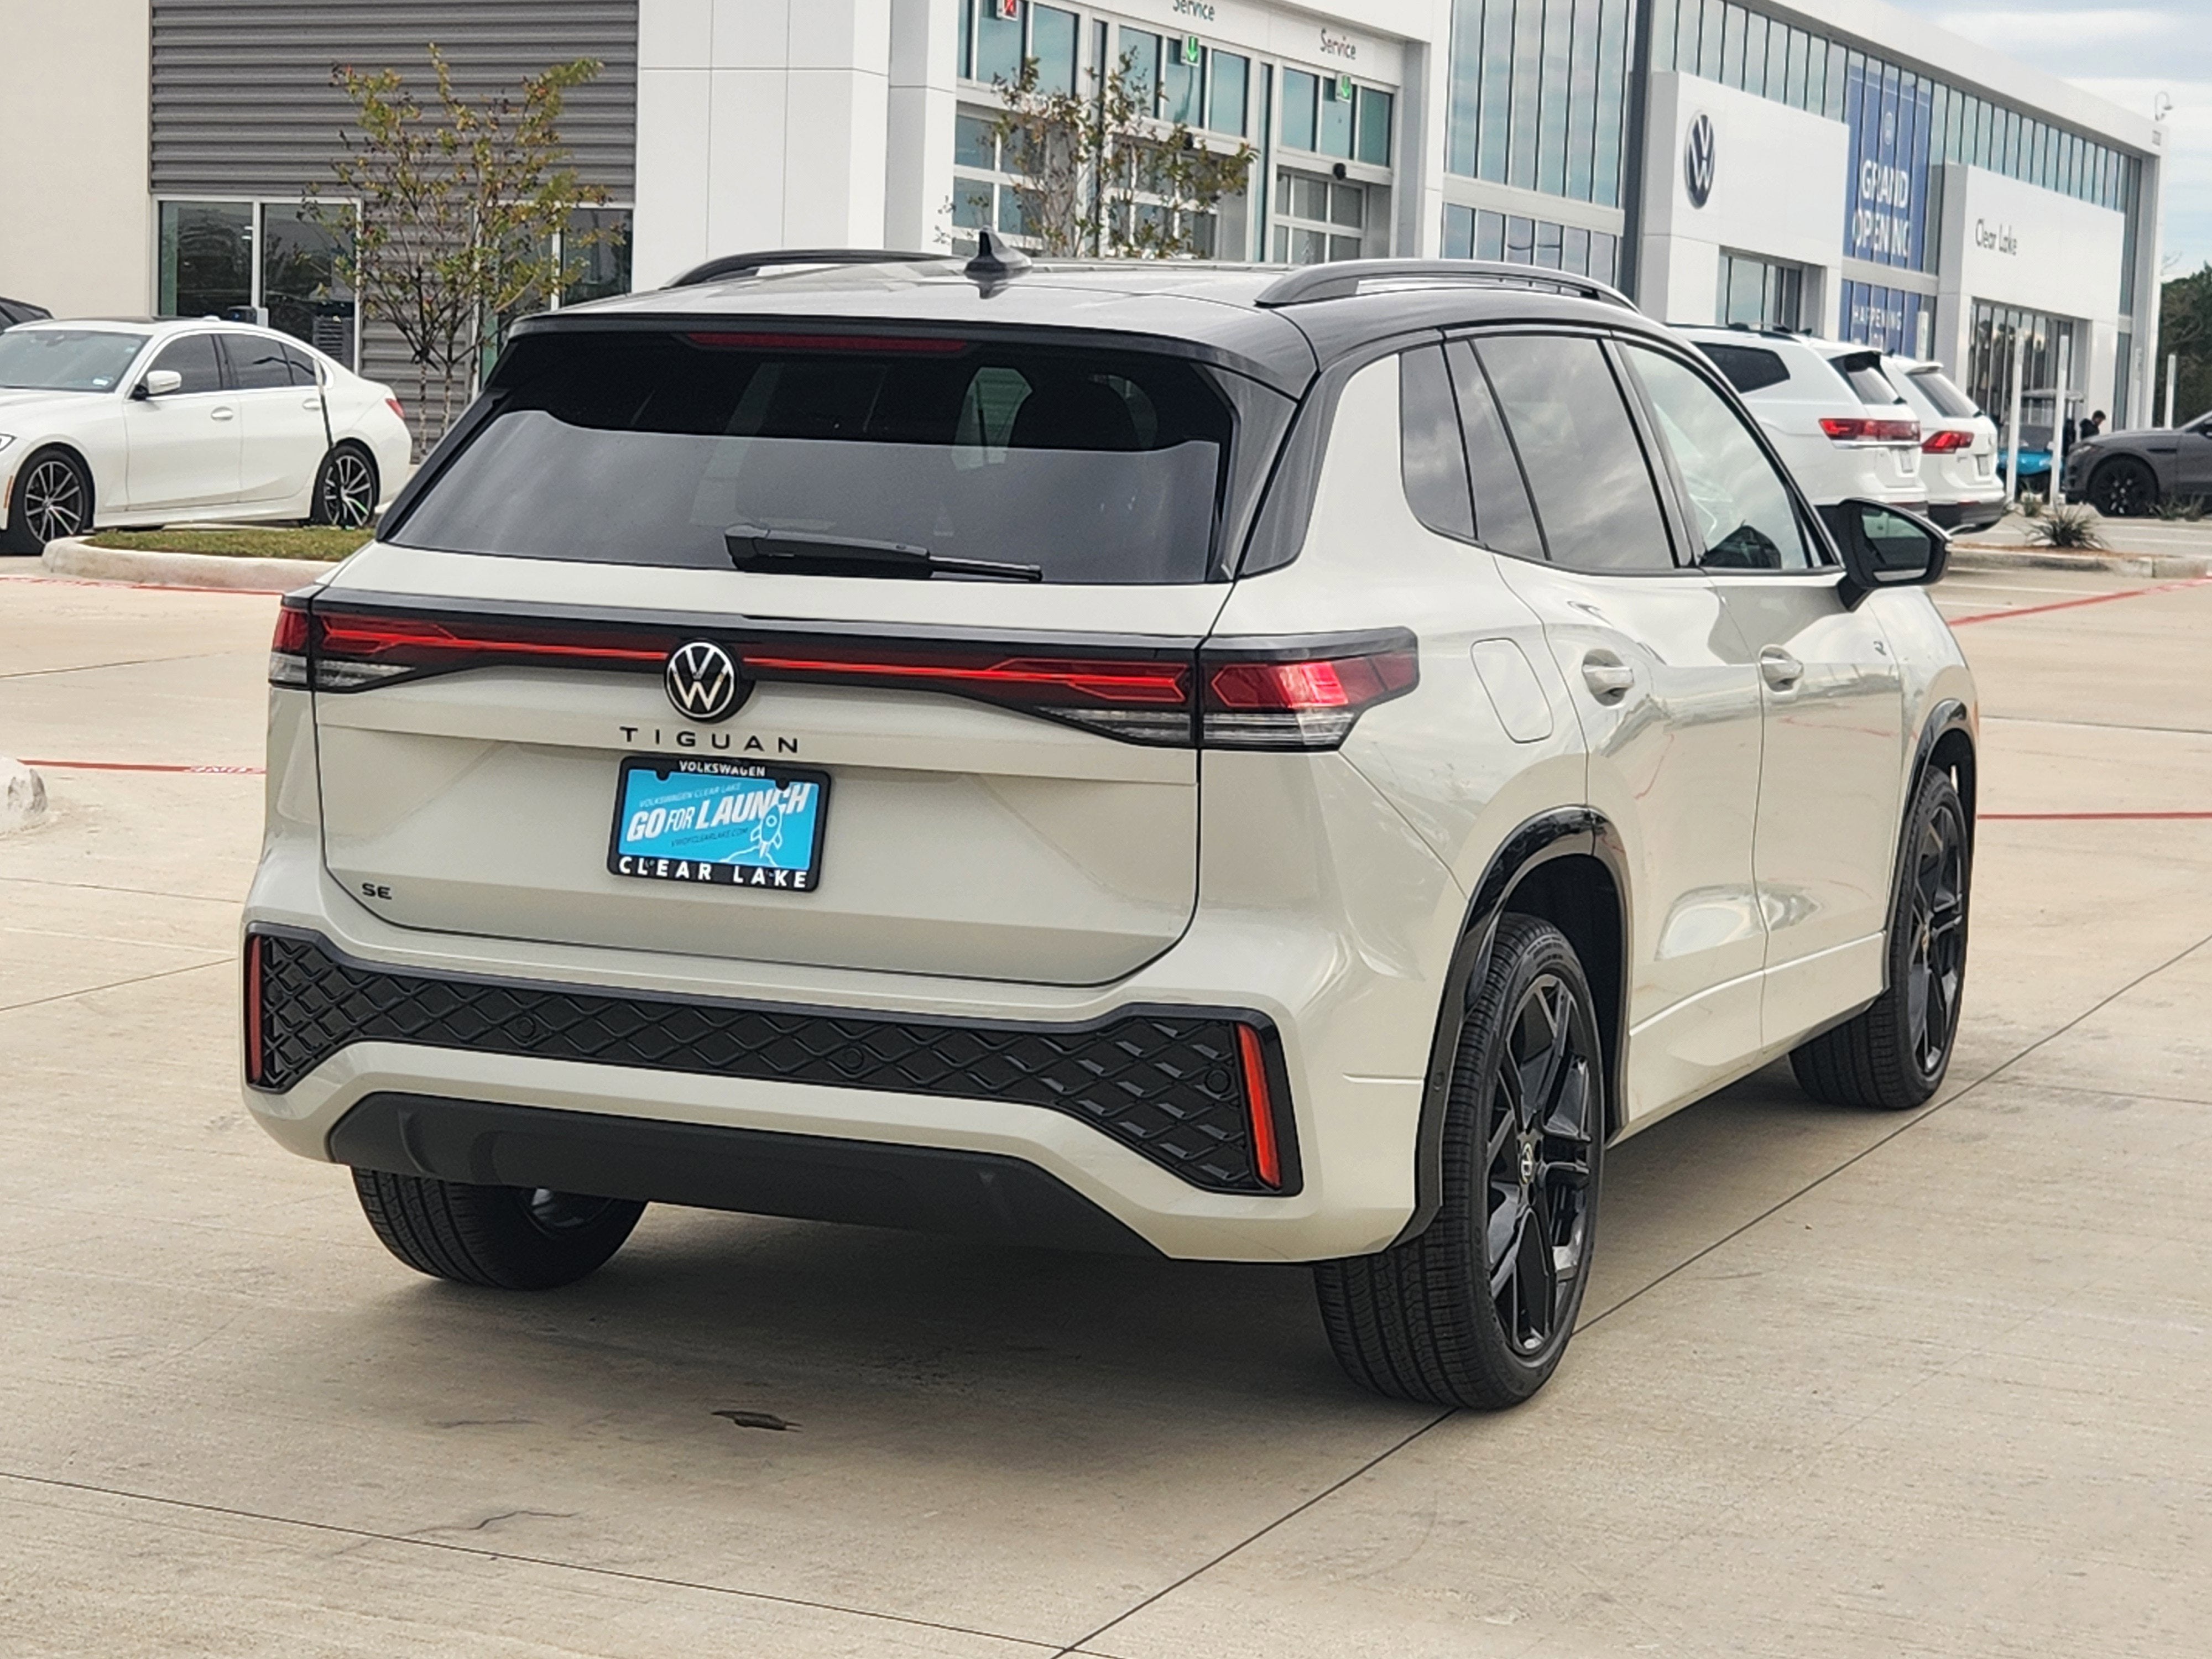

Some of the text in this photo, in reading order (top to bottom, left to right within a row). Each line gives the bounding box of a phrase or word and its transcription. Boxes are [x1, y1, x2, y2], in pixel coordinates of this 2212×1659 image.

[1319, 28, 1357, 60] Service
[1975, 218, 1996, 249] Clear
[619, 726, 798, 753] TIGUAN
[679, 760, 765, 776] VOLKSWAGEN
[627, 782, 812, 842] GO FOR LAUNCH
[619, 857, 807, 889] CLEAR LAKE
[362, 883, 392, 900] SE
